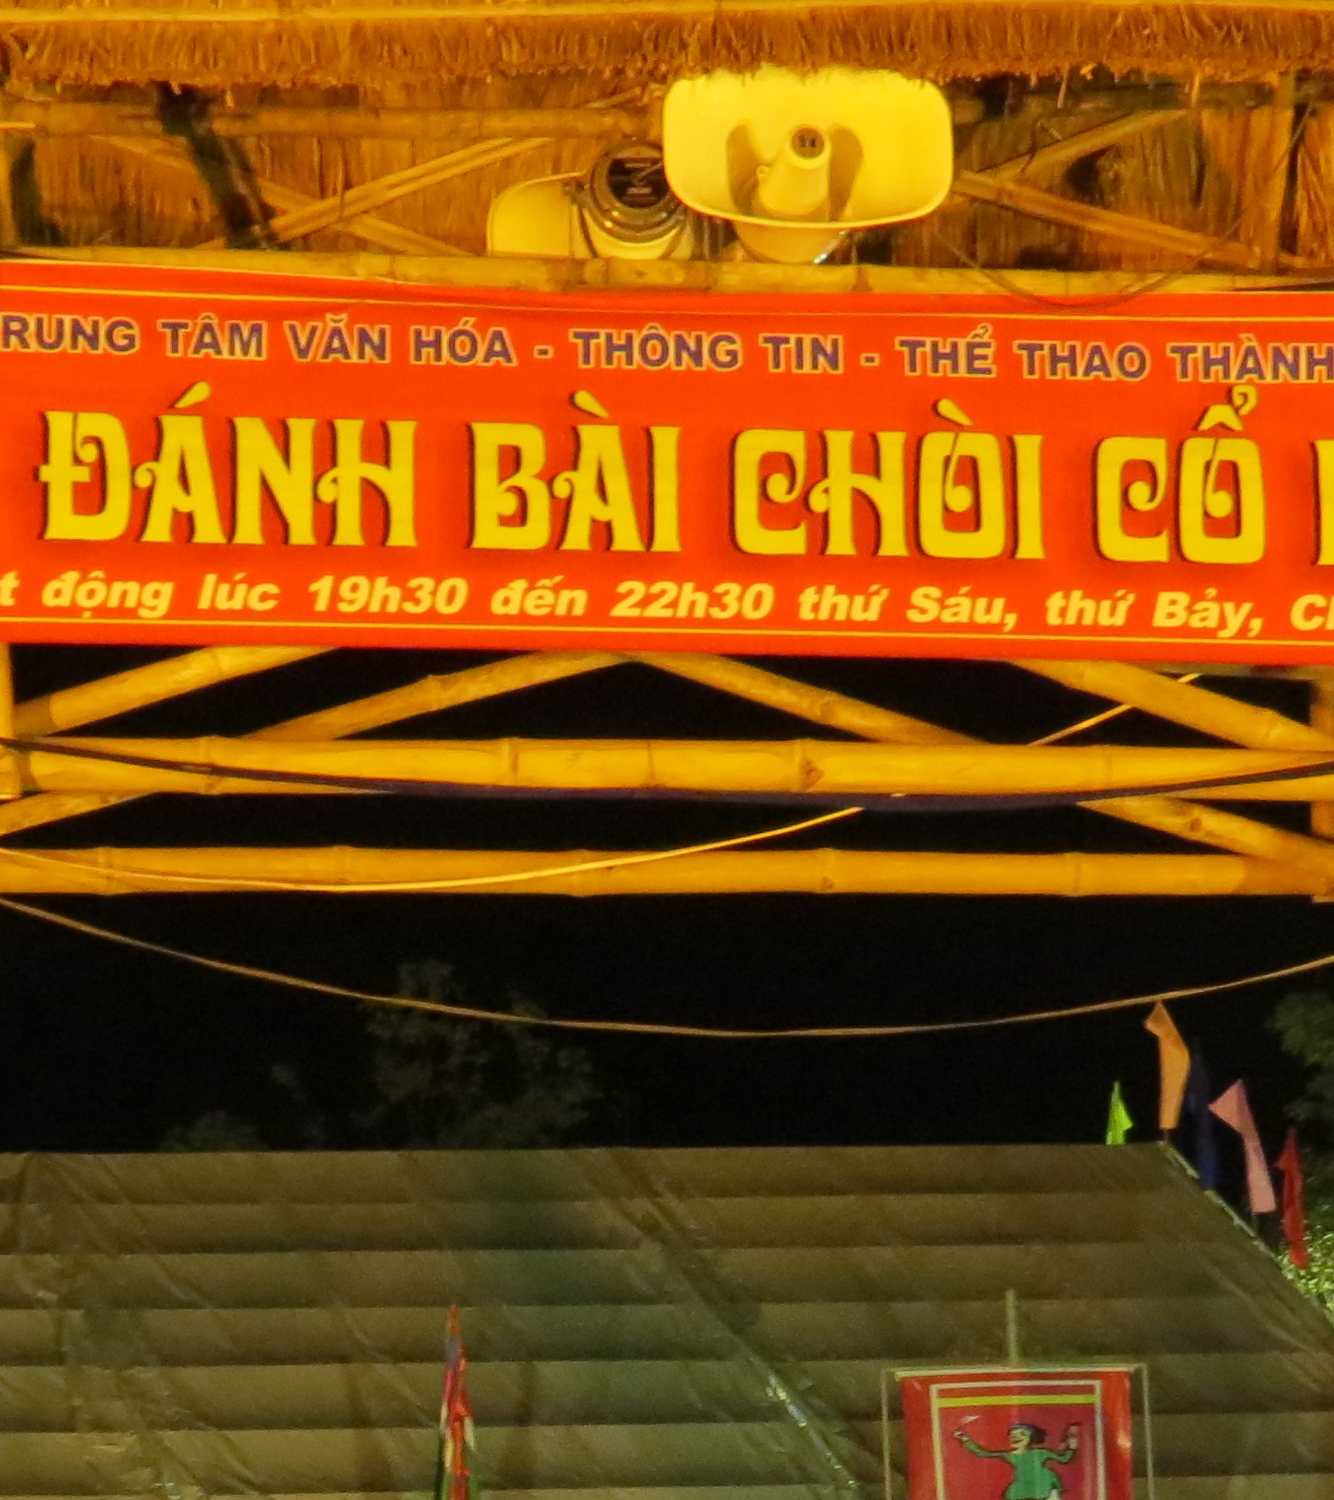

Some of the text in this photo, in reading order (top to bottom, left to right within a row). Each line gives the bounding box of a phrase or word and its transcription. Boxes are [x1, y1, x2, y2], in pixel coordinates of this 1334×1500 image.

[161, 314, 267, 360] TÂM
[283, 317, 391, 364] VĂN
[409, 317, 518, 367] HÓA
[568, 323, 743, 372] THÔNG
[758, 333, 844, 374] TIN
[895, 323, 997, 378] THỂ
[1013, 340, 1149, 382] THAO
[40, 382, 416, 546] ĐÁNH
[472, 391, 681, 551] BÀI
[736, 399, 1044, 558] CHÒI
[1098, 385, 1265, 563] CỔ
[41, 570, 174, 619] động
[198, 573, 280, 611] lúc
[309, 575, 468, 614] 19h30
[491, 576, 588, 616] đến
[610, 581, 775, 619] 22h30
[798, 584, 889, 621] thứ
[907, 586, 1017, 632] Sáu,
[1046, 590, 1135, 626] thứ
[1152, 588, 1264, 637] Bảy,
